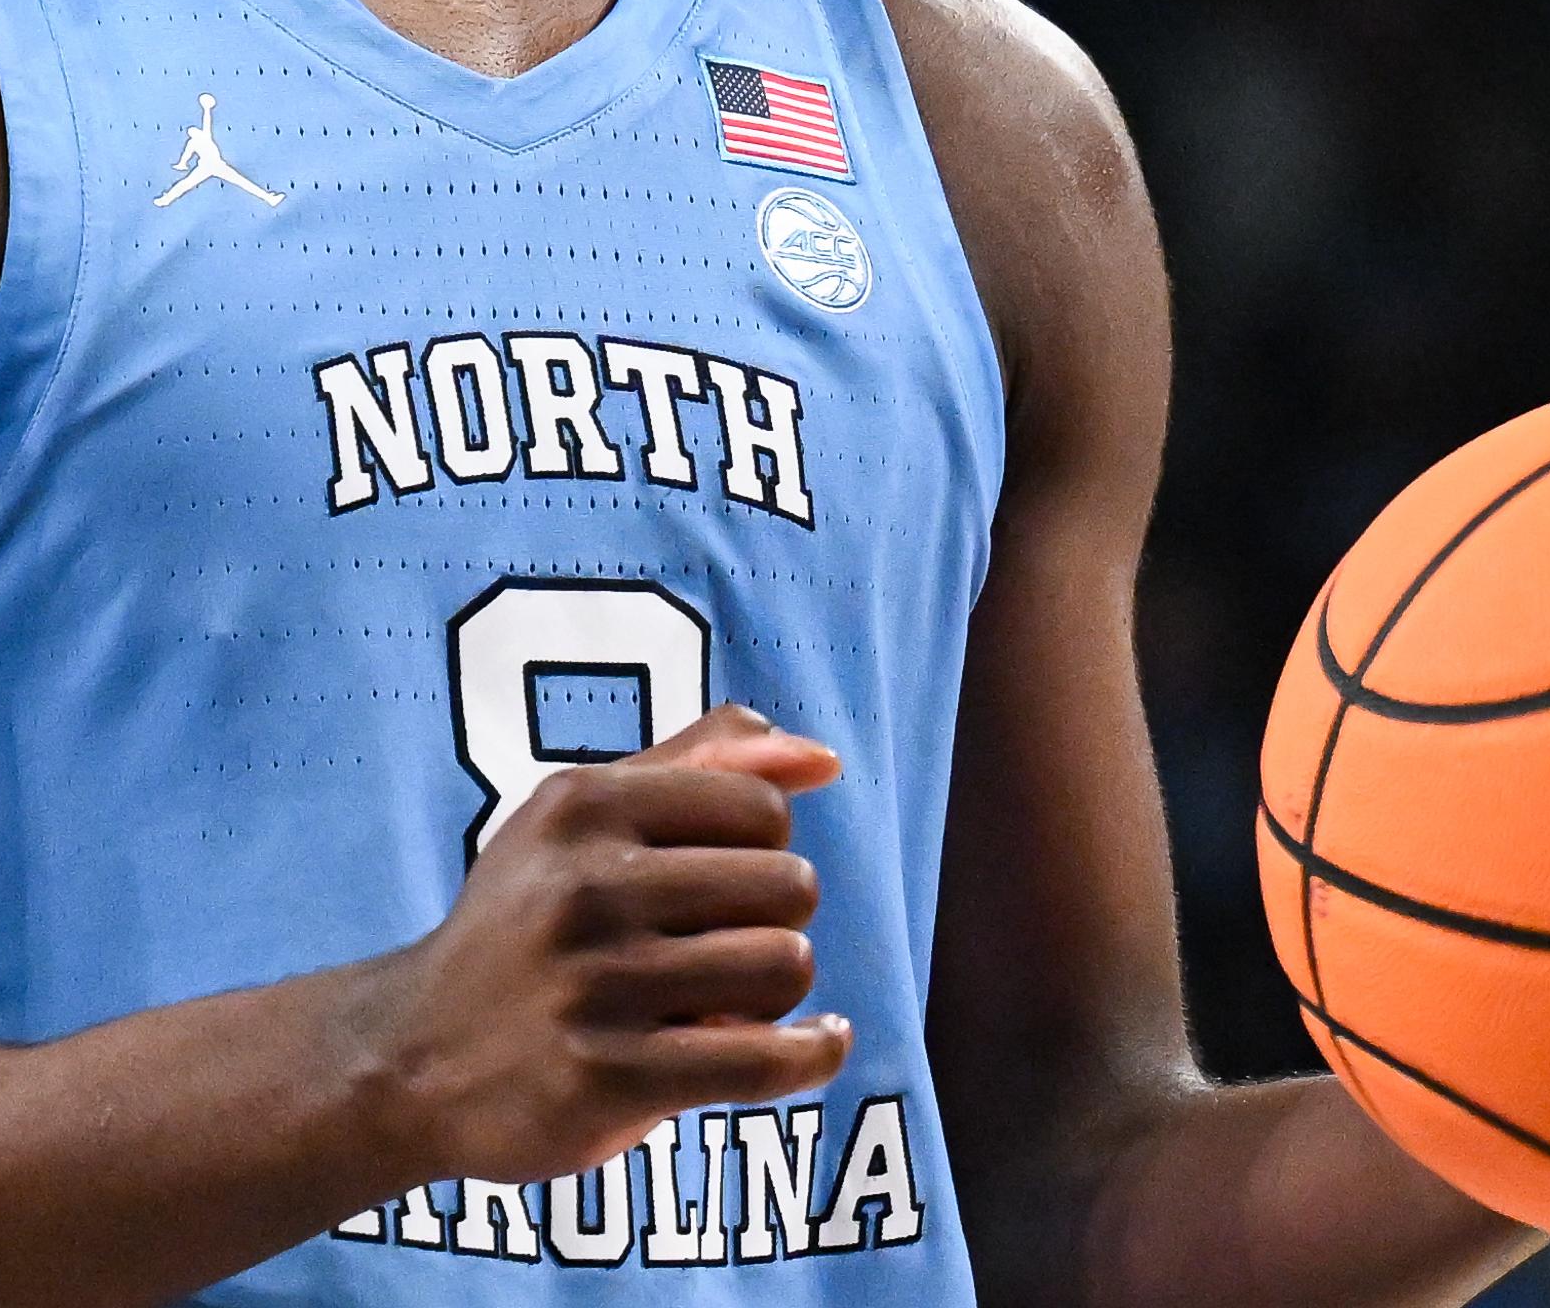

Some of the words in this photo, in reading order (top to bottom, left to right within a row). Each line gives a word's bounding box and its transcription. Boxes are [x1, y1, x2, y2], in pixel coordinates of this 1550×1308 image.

[780, 229, 857, 262] ACC
[313, 330, 816, 532] NORTH
[329, 1094, 923, 1269] ROLINA
